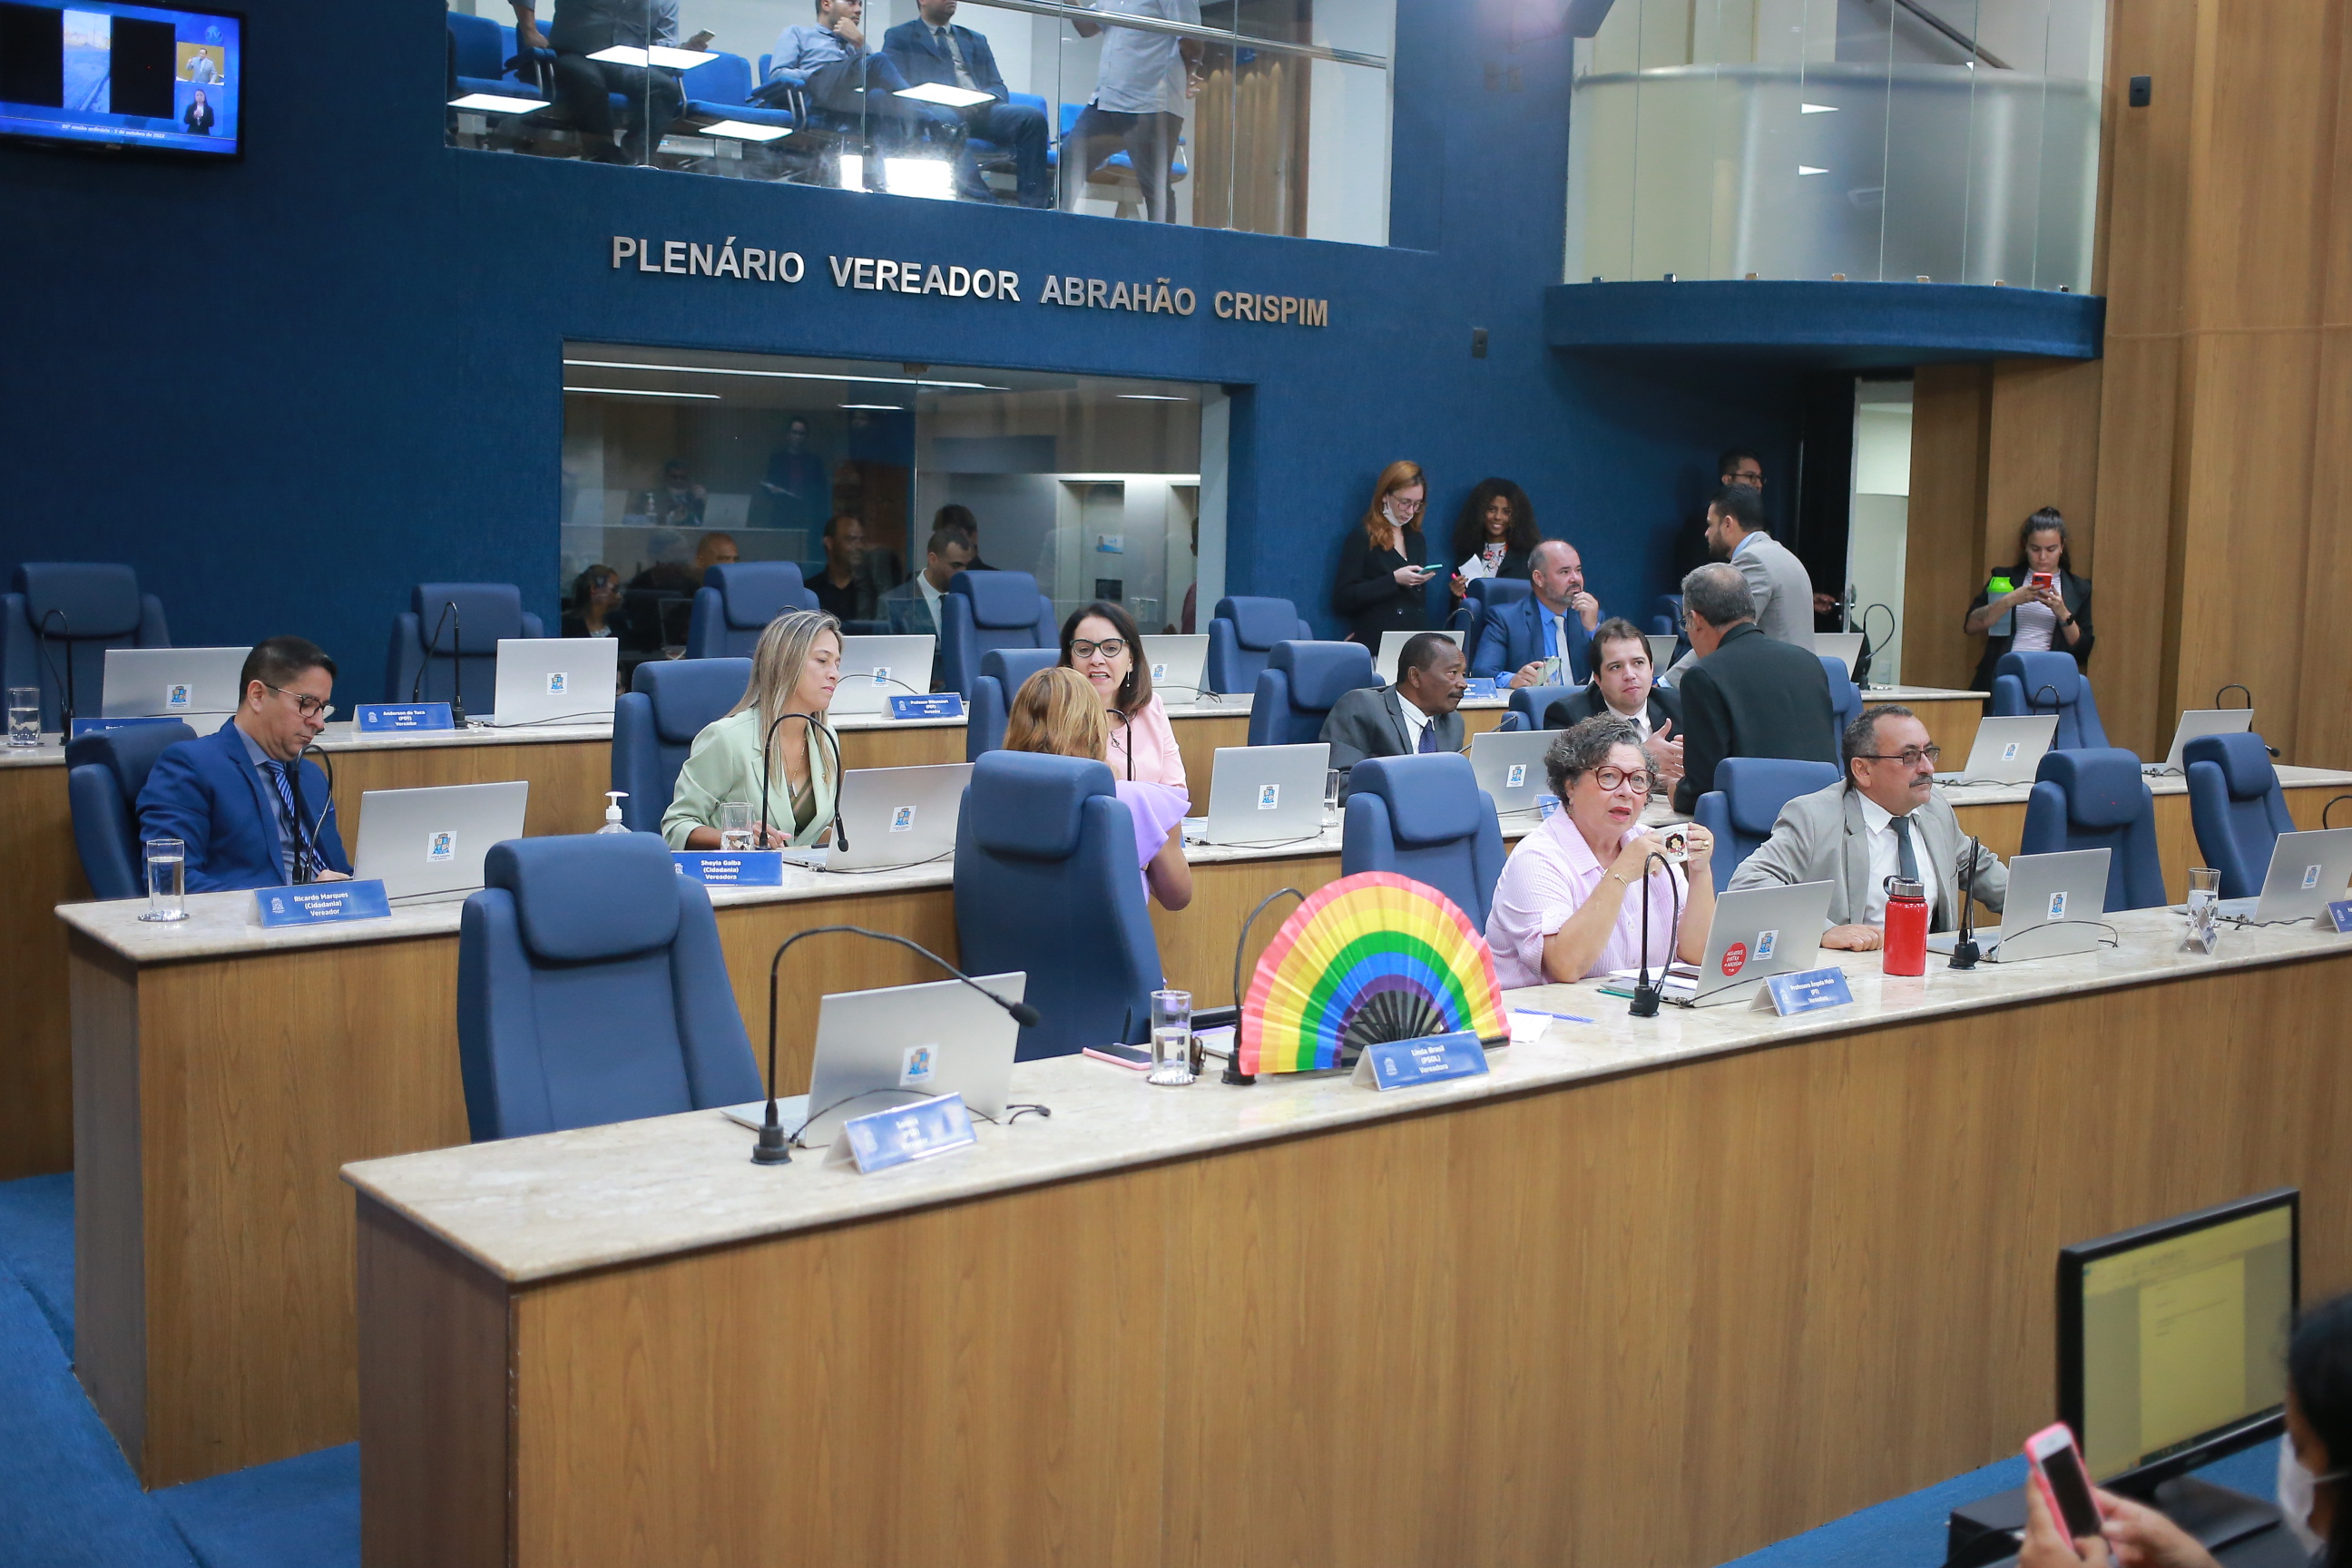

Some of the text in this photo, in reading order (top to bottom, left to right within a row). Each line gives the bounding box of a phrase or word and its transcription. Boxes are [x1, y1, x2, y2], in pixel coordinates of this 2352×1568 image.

[612, 236, 1328, 328] PLENÁRIO VEREADOR ABRAHÃO CRISPIM
[701, 859, 722, 867] Sheyla
[702, 866, 740, 874] (Cidadania)
[293, 892, 348, 903] Ricardo Marques
[304, 900, 342, 909] (Cidadania)
[309, 908, 340, 916] Vereador
[1410, 1044, 1446, 1056] Linda Brasil
[1420, 1054, 1442, 1065] (PSOL)
[1418, 1063, 1449, 1074] Vereadora
